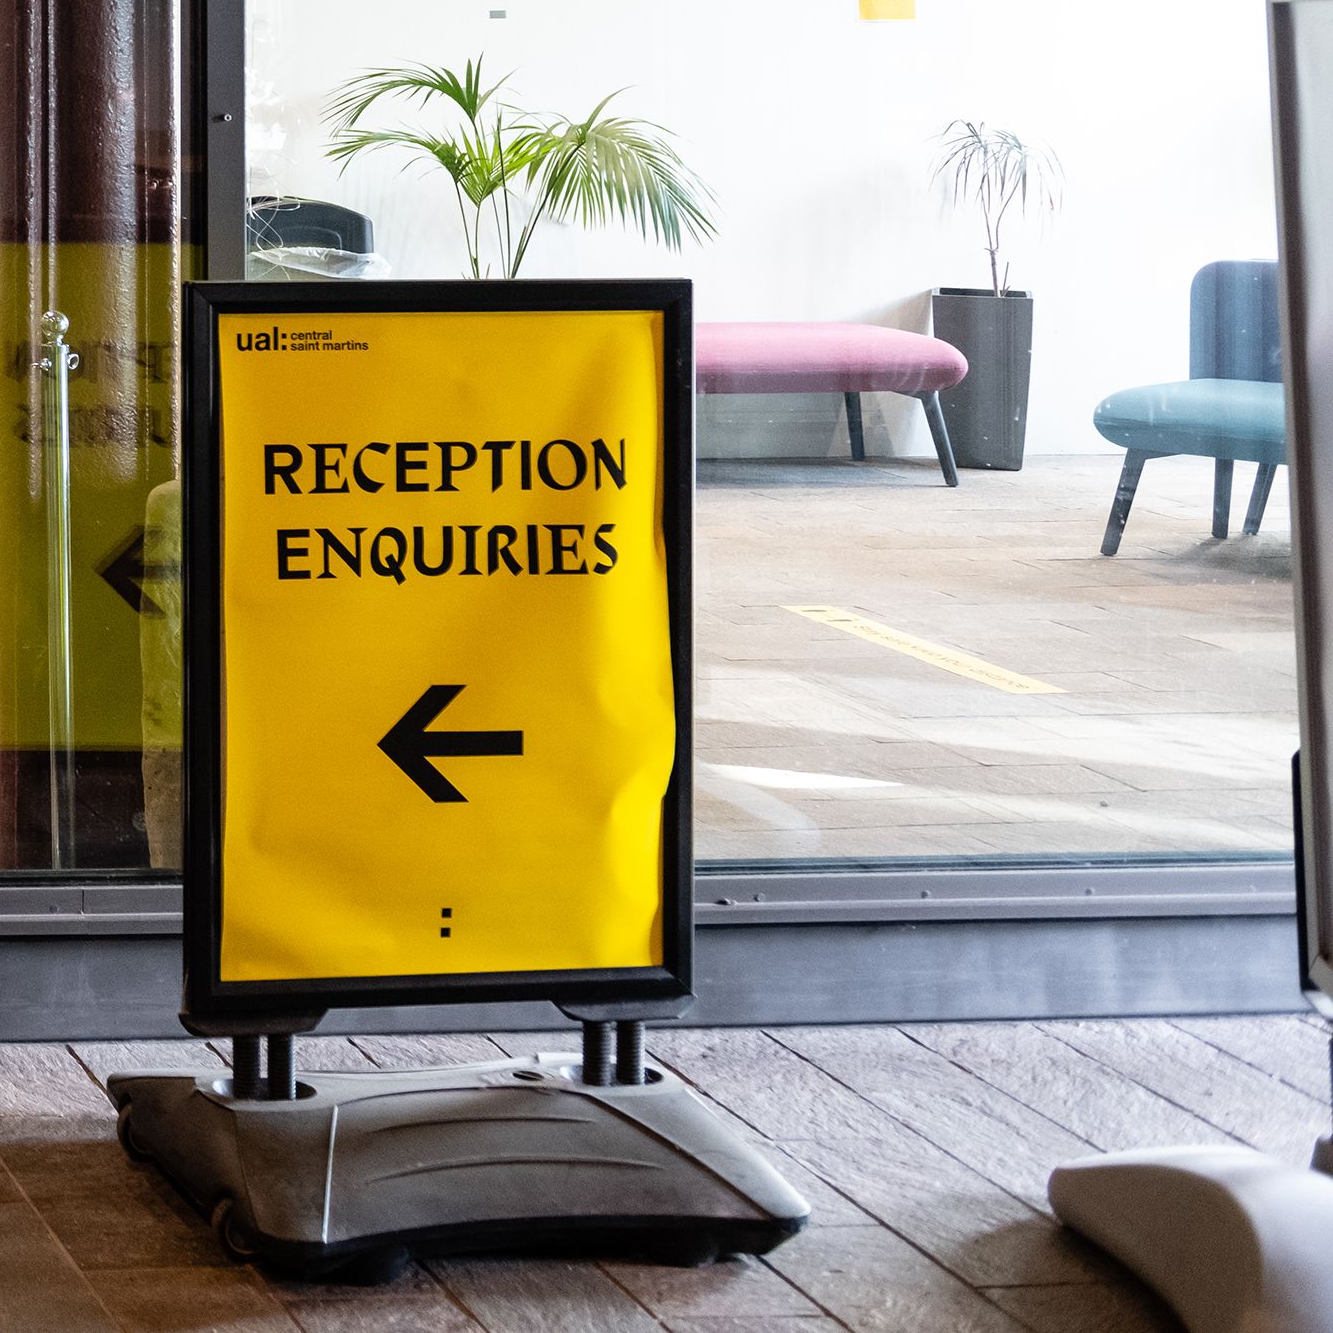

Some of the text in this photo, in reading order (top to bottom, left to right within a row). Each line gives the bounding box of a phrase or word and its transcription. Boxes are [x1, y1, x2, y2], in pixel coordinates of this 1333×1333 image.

[236, 326, 333, 352] ual: central
[290, 340, 369, 351] saint martins
[264, 438, 627, 495] RECEPTION
[277, 523, 619, 585] ENQUIRIES
